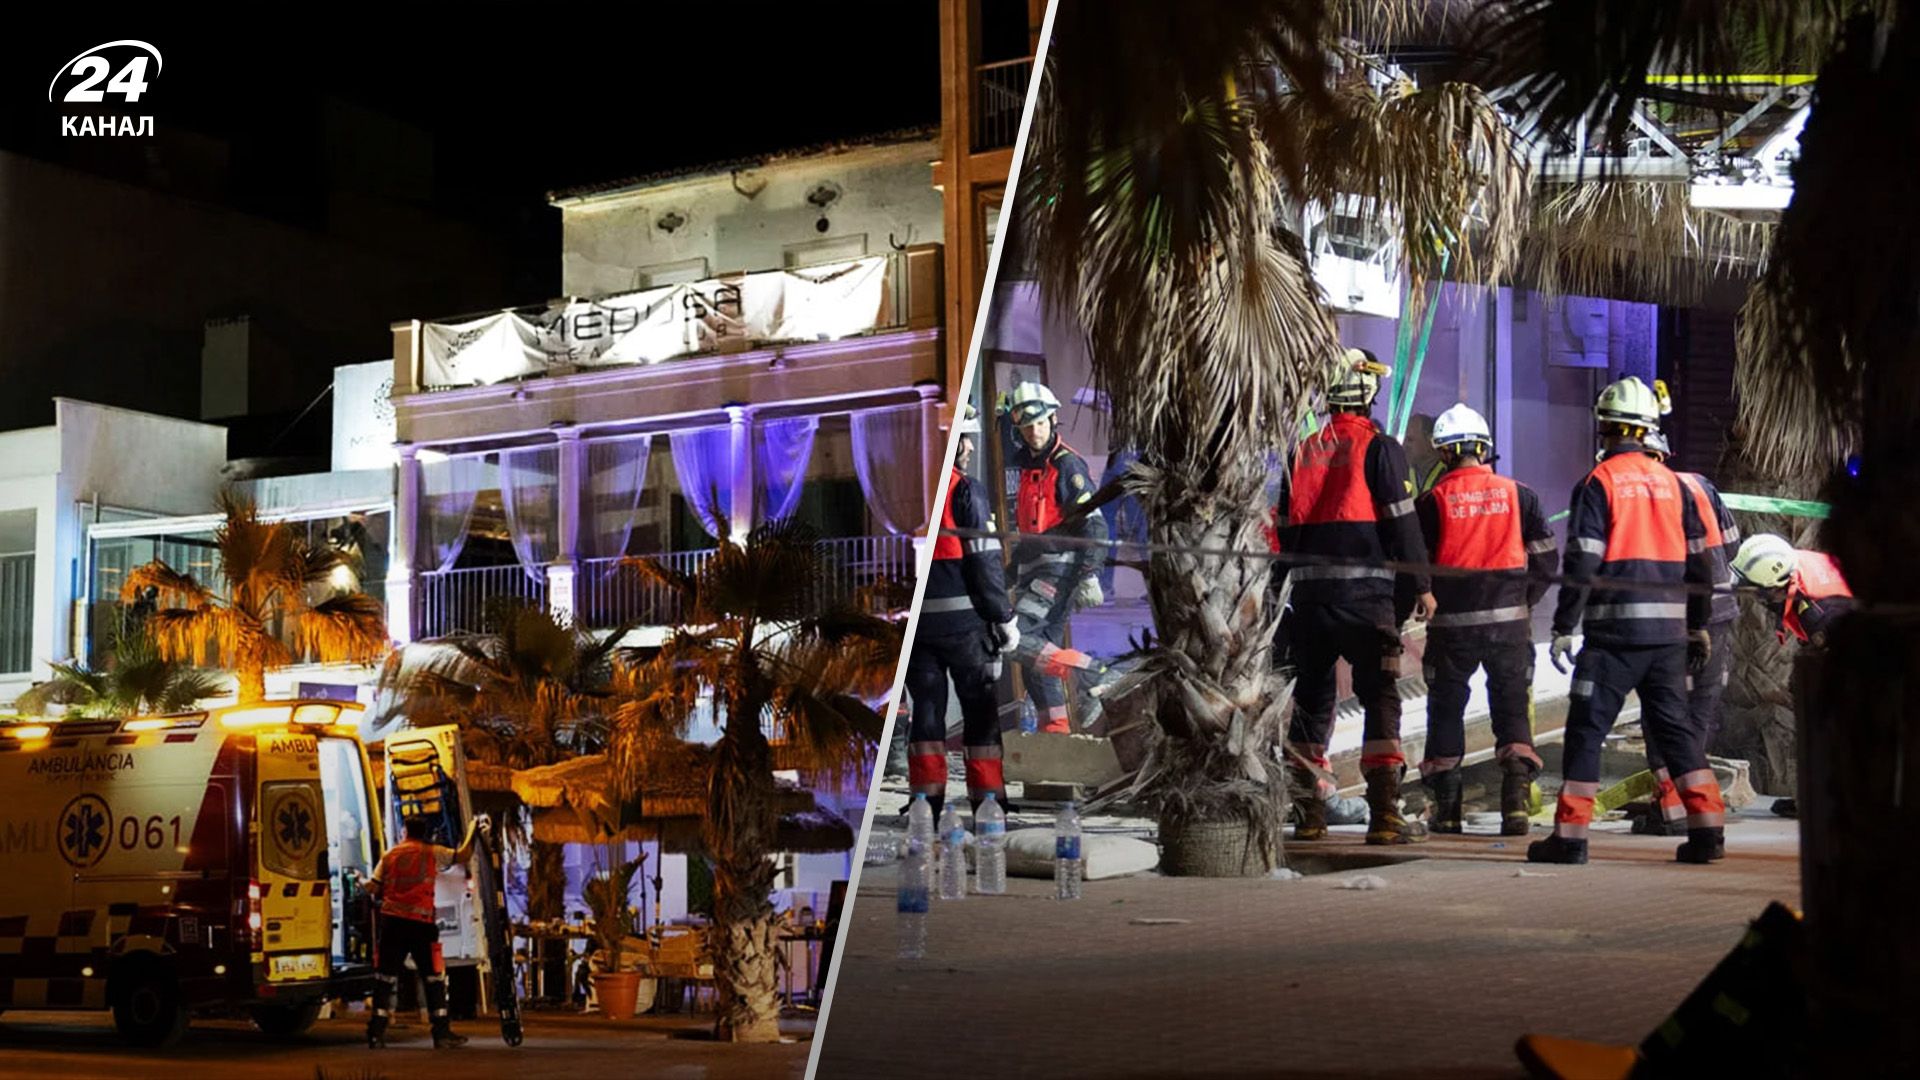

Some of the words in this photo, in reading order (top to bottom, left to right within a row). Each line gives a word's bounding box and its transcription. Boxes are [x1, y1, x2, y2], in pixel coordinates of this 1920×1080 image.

[1448, 488, 1508, 504] BOMBERS
[1450, 506, 1466, 519] DE
[119, 815, 181, 850] 061
